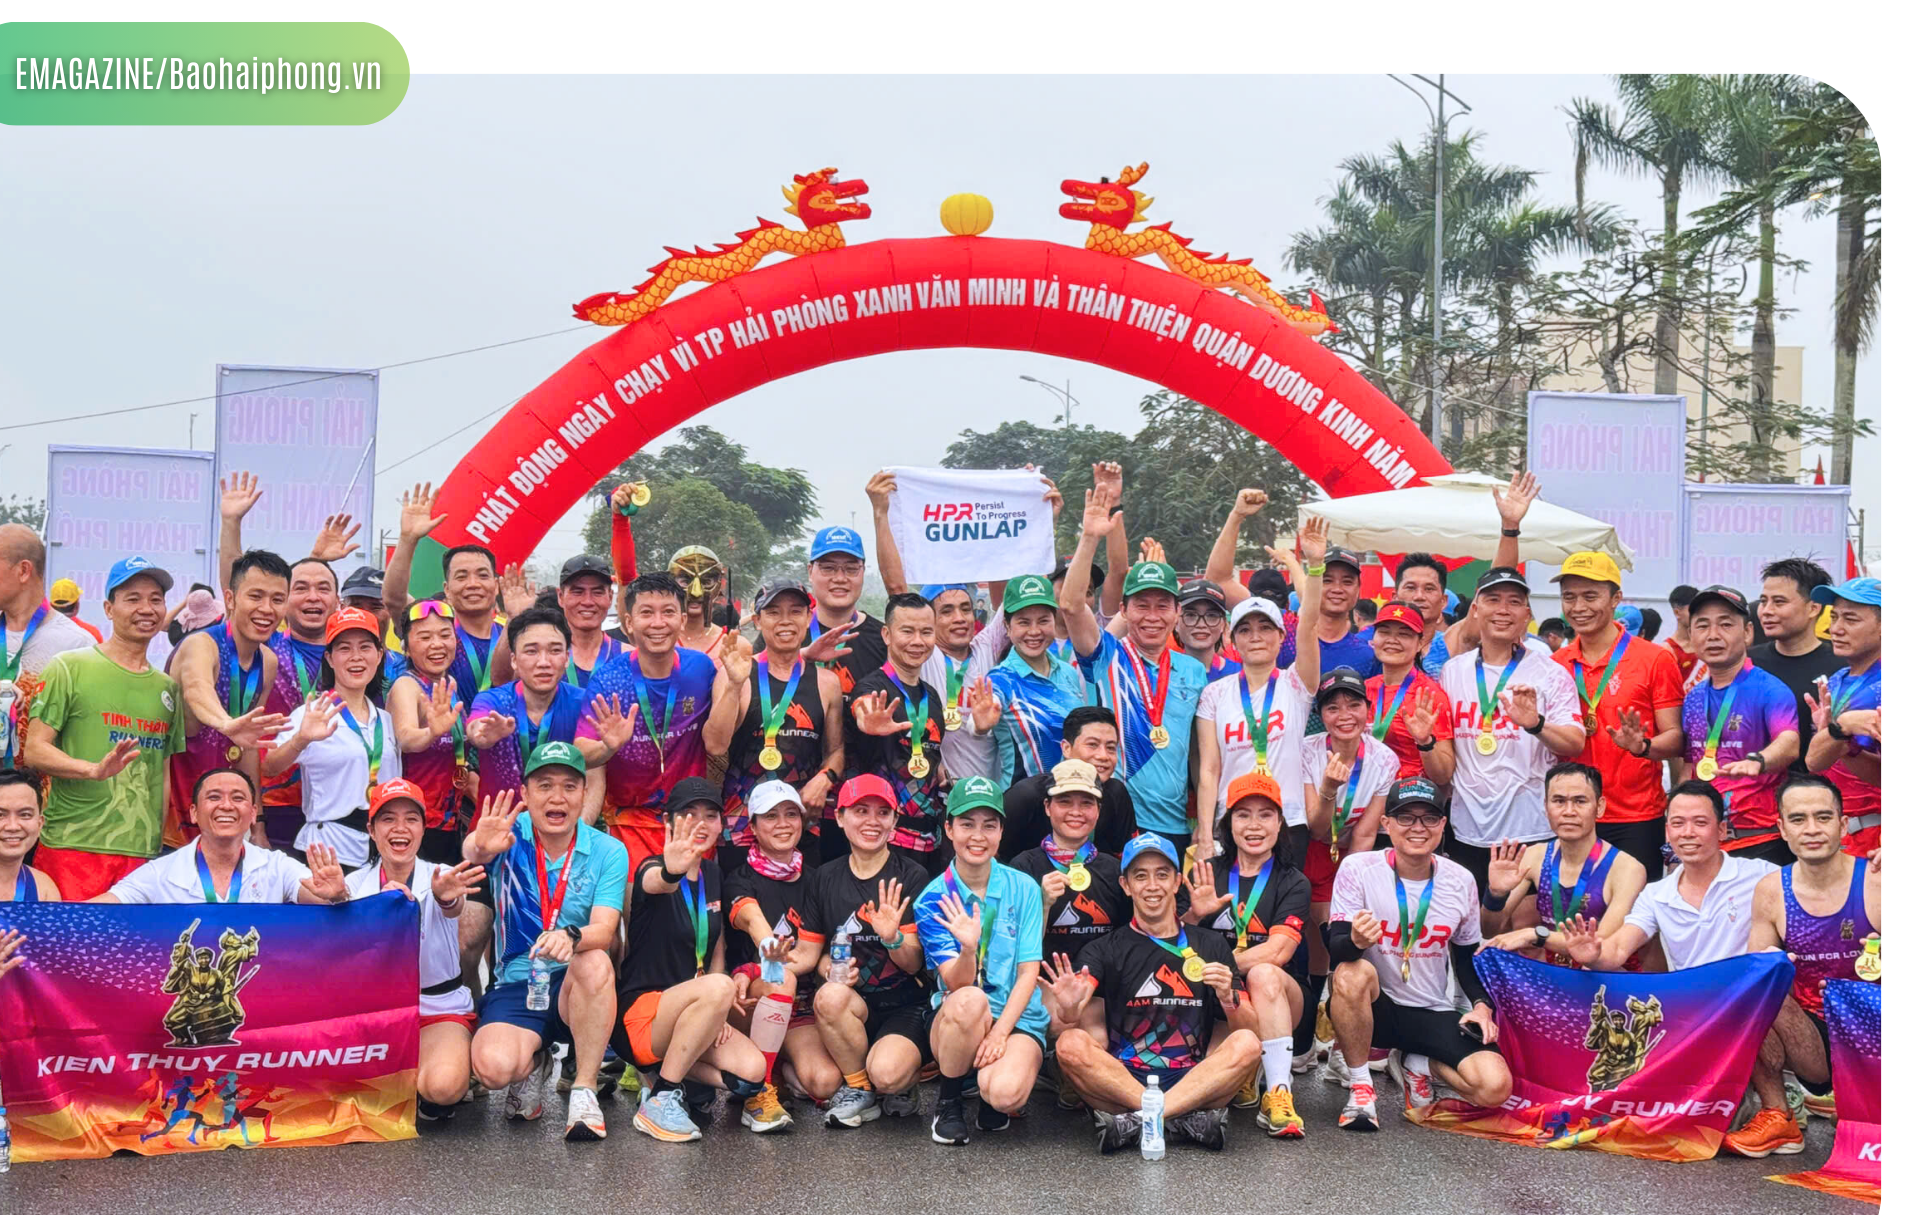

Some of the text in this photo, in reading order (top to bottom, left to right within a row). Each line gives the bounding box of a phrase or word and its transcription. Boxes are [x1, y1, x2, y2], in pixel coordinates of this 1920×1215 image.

[465, 273, 1418, 544] PHÁT ĐỘNG NGÀY CHẠY VÌ TP HẢI PHÒNG XANH VĂN MINH VÀ THÂN THIỆN QUẬN DƯƠNG KINH NĂM
[923, 503, 974, 522] HPR
[974, 501, 1005, 511] Persist
[975, 510, 1027, 521] To Progress
[925, 519, 1027, 542] GUNLAP
[101, 712, 133, 728] TINH
[1818, 952, 1840, 961] FOR
[1843, 949, 1865, 958] LOV
[1152, 997, 1203, 1007] RUNNERS
[37, 1044, 389, 1078] KIEN THUY RUNNER
